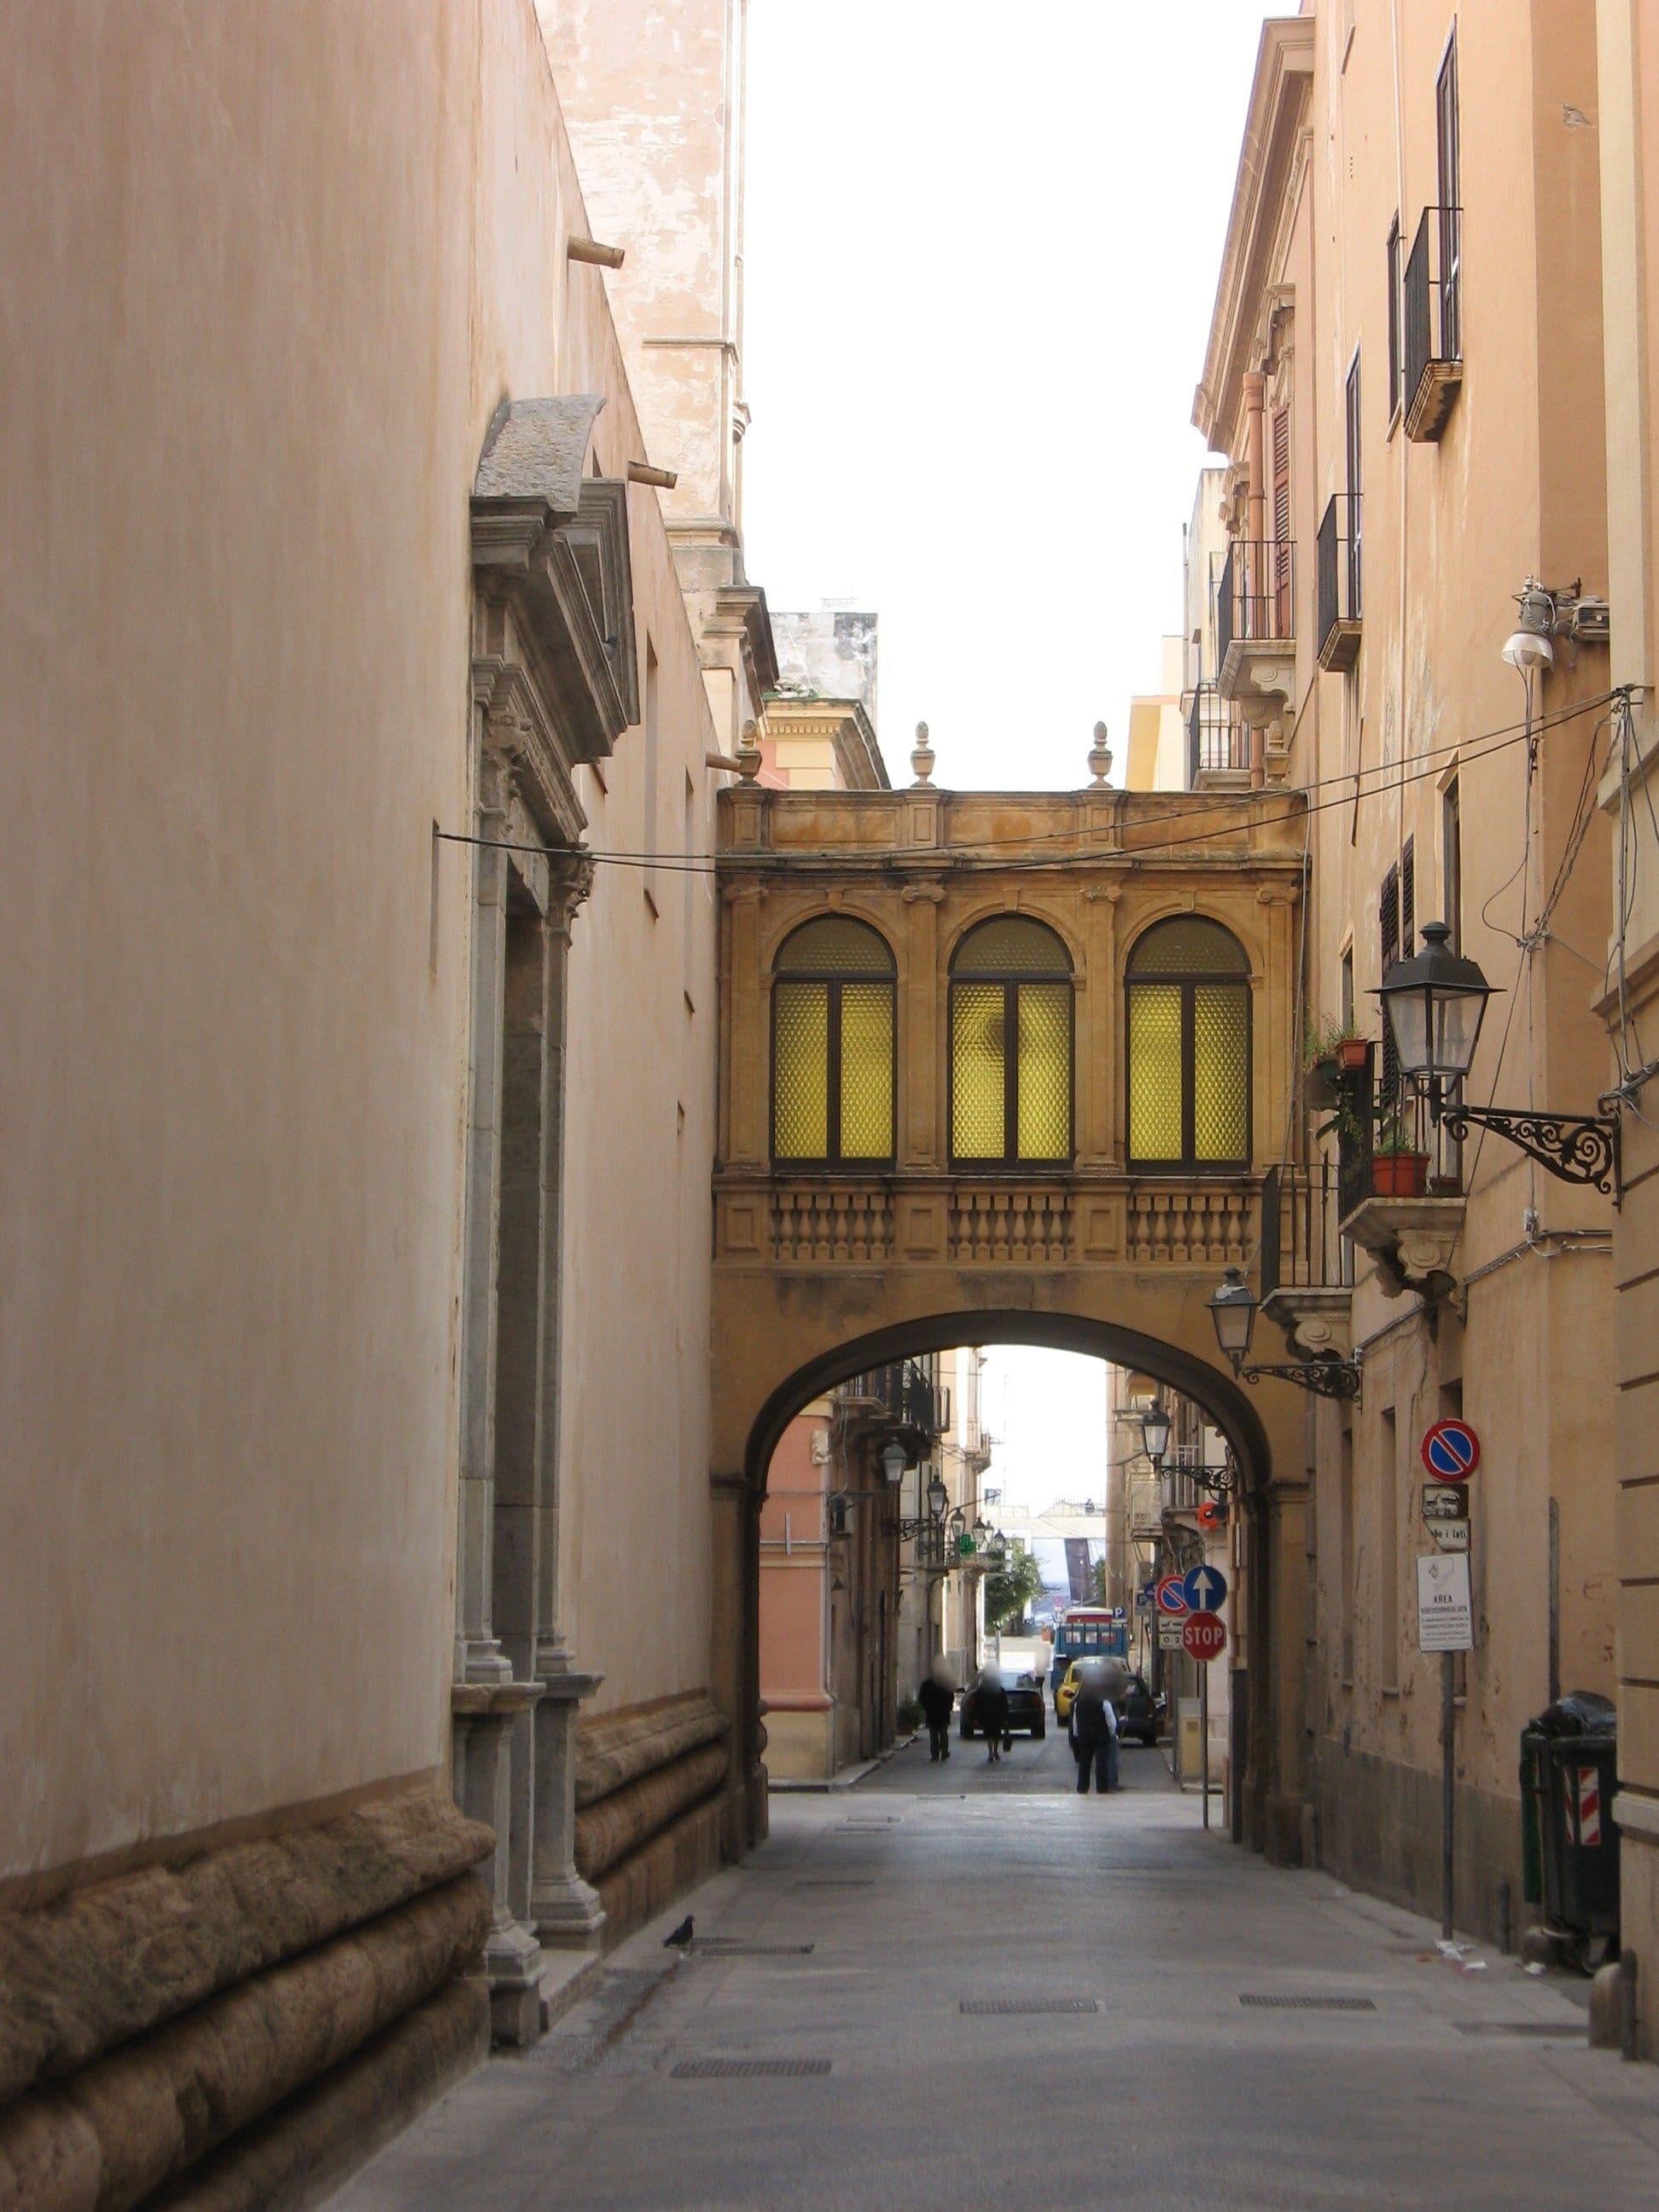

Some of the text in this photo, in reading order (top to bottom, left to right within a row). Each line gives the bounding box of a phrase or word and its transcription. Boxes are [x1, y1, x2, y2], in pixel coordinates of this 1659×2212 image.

[1434, 1595, 1452, 1604] AREA
[1115, 1607, 1123, 1618] P
[1185, 1626, 1223, 1645] STOP
